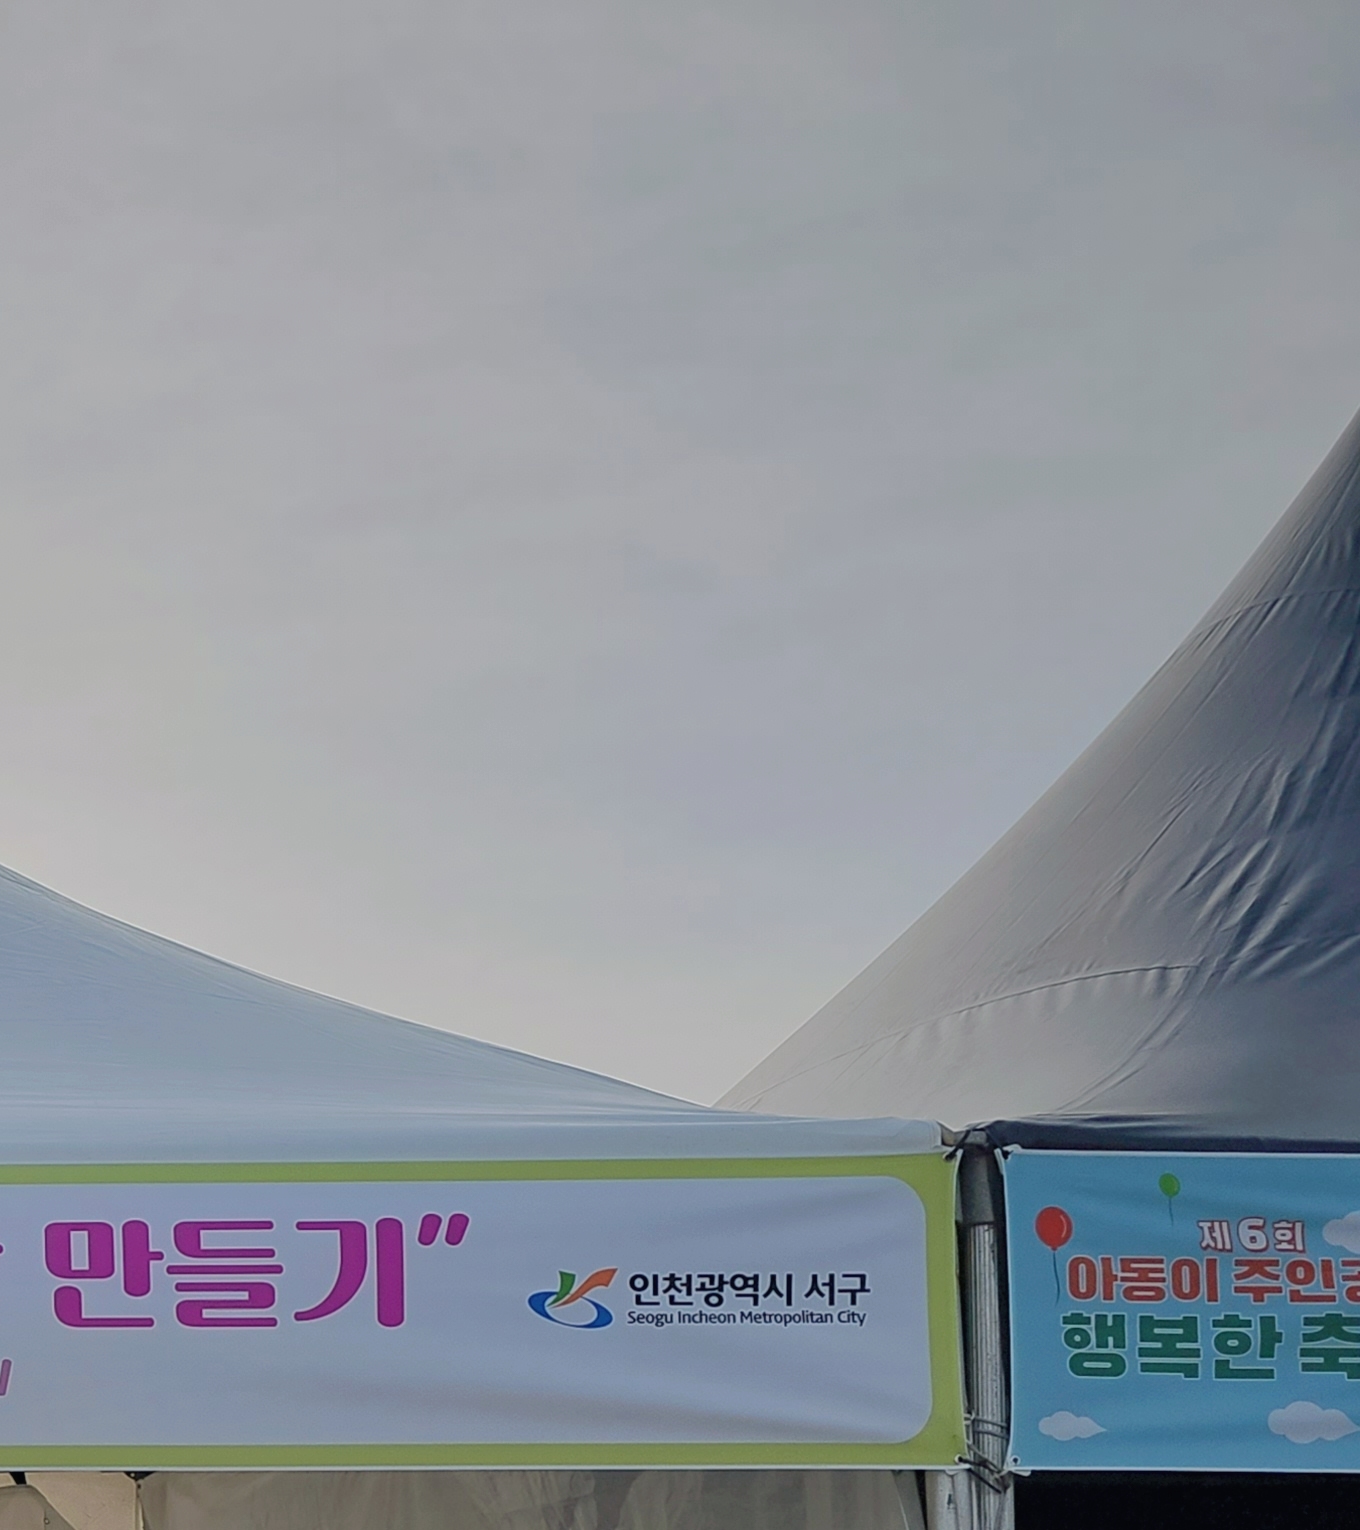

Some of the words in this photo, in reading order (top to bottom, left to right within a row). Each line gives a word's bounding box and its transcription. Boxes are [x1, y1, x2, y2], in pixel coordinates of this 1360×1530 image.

[628, 1272, 794, 1308] 인천광역시
[804, 1273, 872, 1307] 서구
[1067, 1255, 1220, 1304] 아동이
[627, 1309, 674, 1328] Seogu
[677, 1309, 737, 1325] Incheon
[739, 1309, 834, 1328] Metropolitan
[837, 1309, 868, 1328] City
[1062, 1310, 1284, 1381] 행복한
